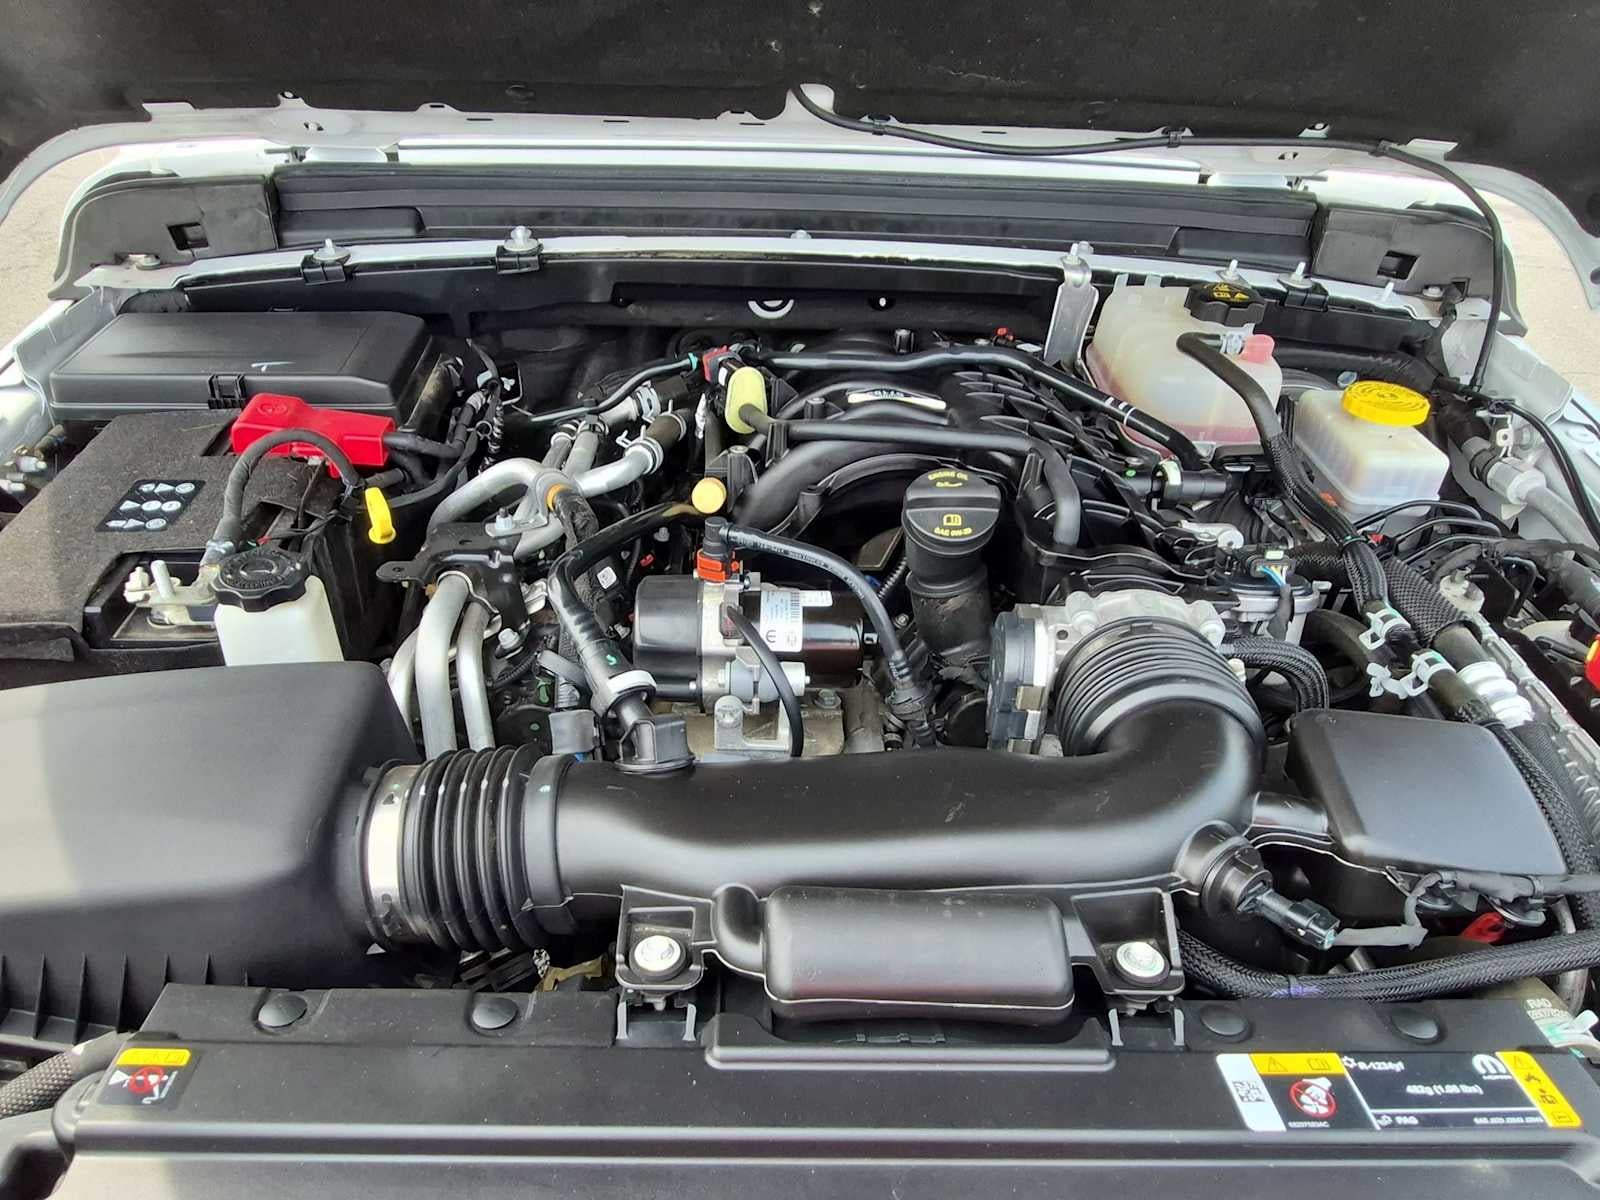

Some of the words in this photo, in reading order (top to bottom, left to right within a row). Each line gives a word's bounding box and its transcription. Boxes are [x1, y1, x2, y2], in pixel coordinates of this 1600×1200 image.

[928, 471, 956, 481] ENGINE
[956, 471, 968, 481] OIL
[934, 527, 950, 536] SAE
